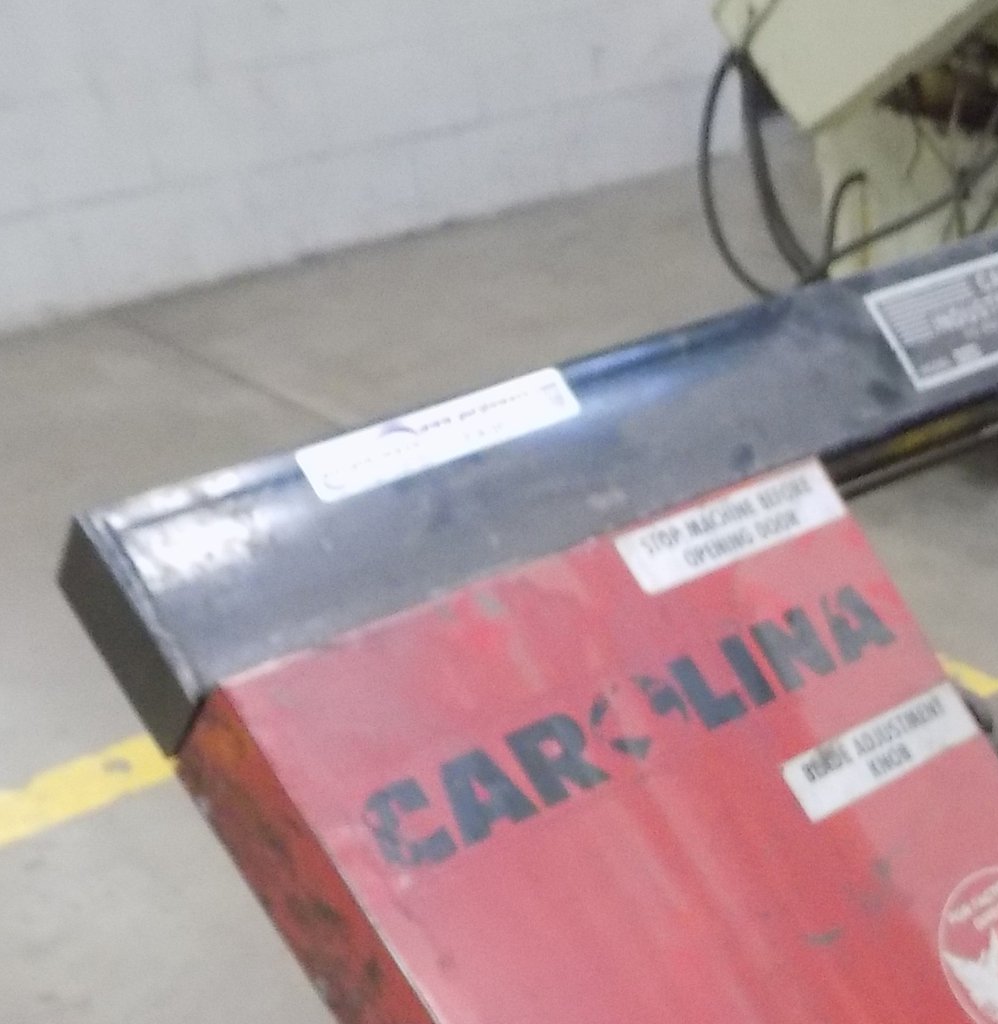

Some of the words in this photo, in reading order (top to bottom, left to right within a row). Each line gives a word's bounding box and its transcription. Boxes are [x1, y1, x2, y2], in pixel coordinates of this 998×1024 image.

[638, 524, 681, 556] STOP
[684, 498, 756, 538] MACHINE
[757, 475, 813, 510] BEFORE
[684, 526, 754, 567] OPENING
[755, 510, 800, 539] DOOR
[362, 585, 896, 869] CAROLINA
[852, 695, 946, 757] ADJUSTMENT
[866, 741, 912, 778] KNOB
